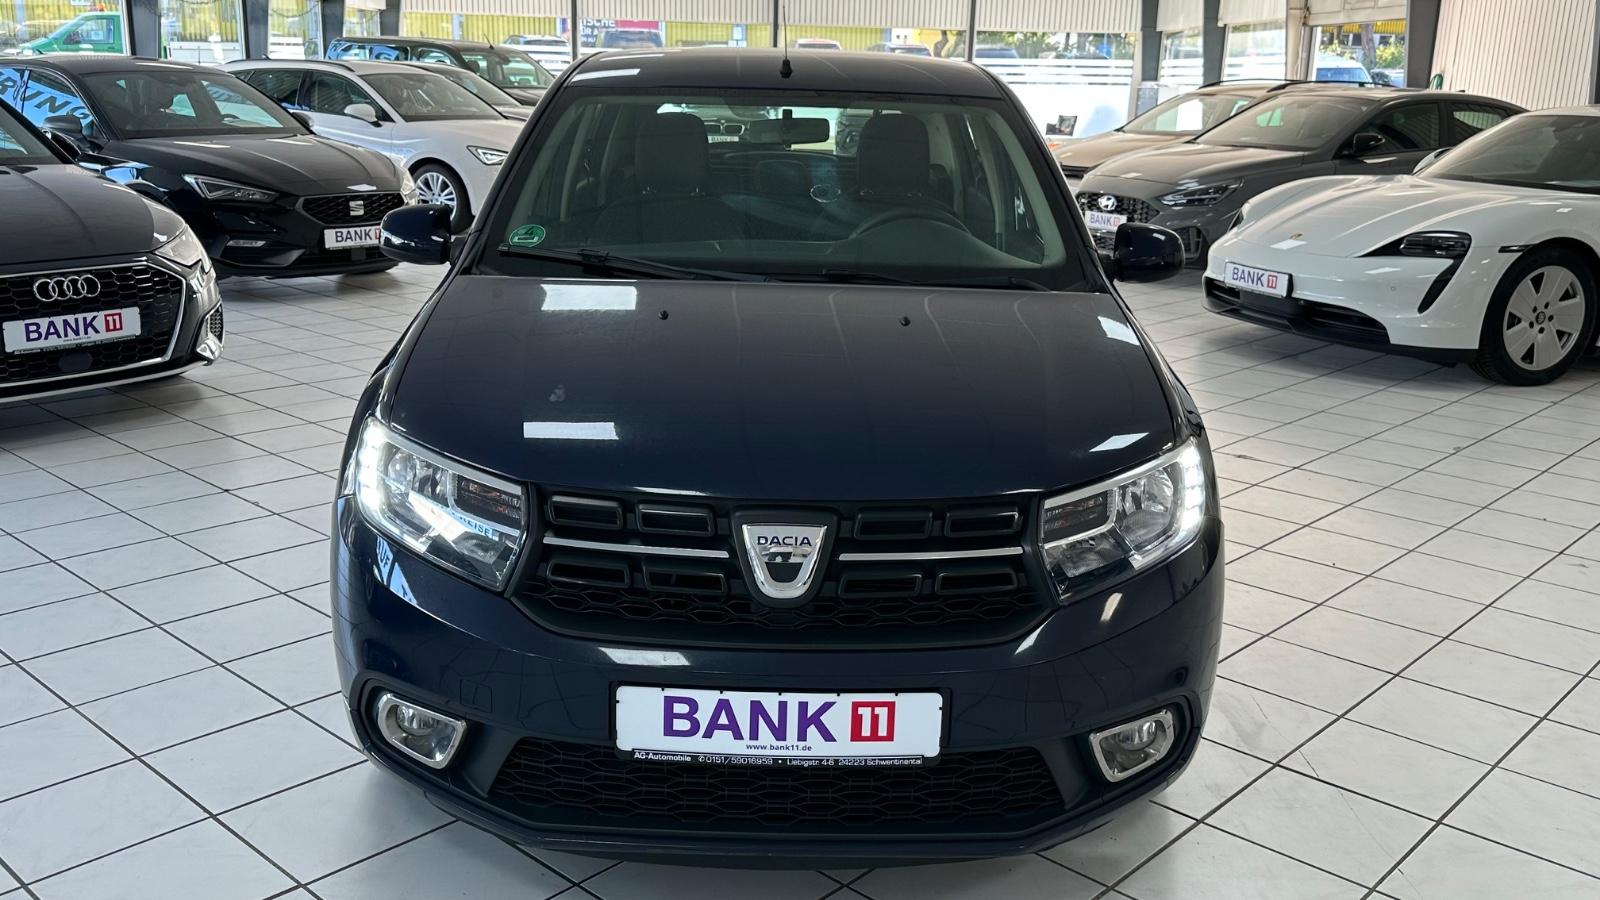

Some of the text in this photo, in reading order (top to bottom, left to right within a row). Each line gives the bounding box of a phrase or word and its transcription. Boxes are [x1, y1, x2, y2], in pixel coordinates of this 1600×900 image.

[1090, 213, 1112, 227] BANK
[335, 229, 373, 243] BANK
[1232, 267, 1277, 288] BANK 11
[24, 314, 122, 342] BANK 11
[757, 535, 812, 546] DACIA
[663, 695, 891, 742] BANK 11
[746, 744, 812, 752] www.bank11.de
[634, 752, 692, 762] AG-Automobile
[838, 758, 865, 766] 24223
[866, 758, 923, 766] Schwentinental
